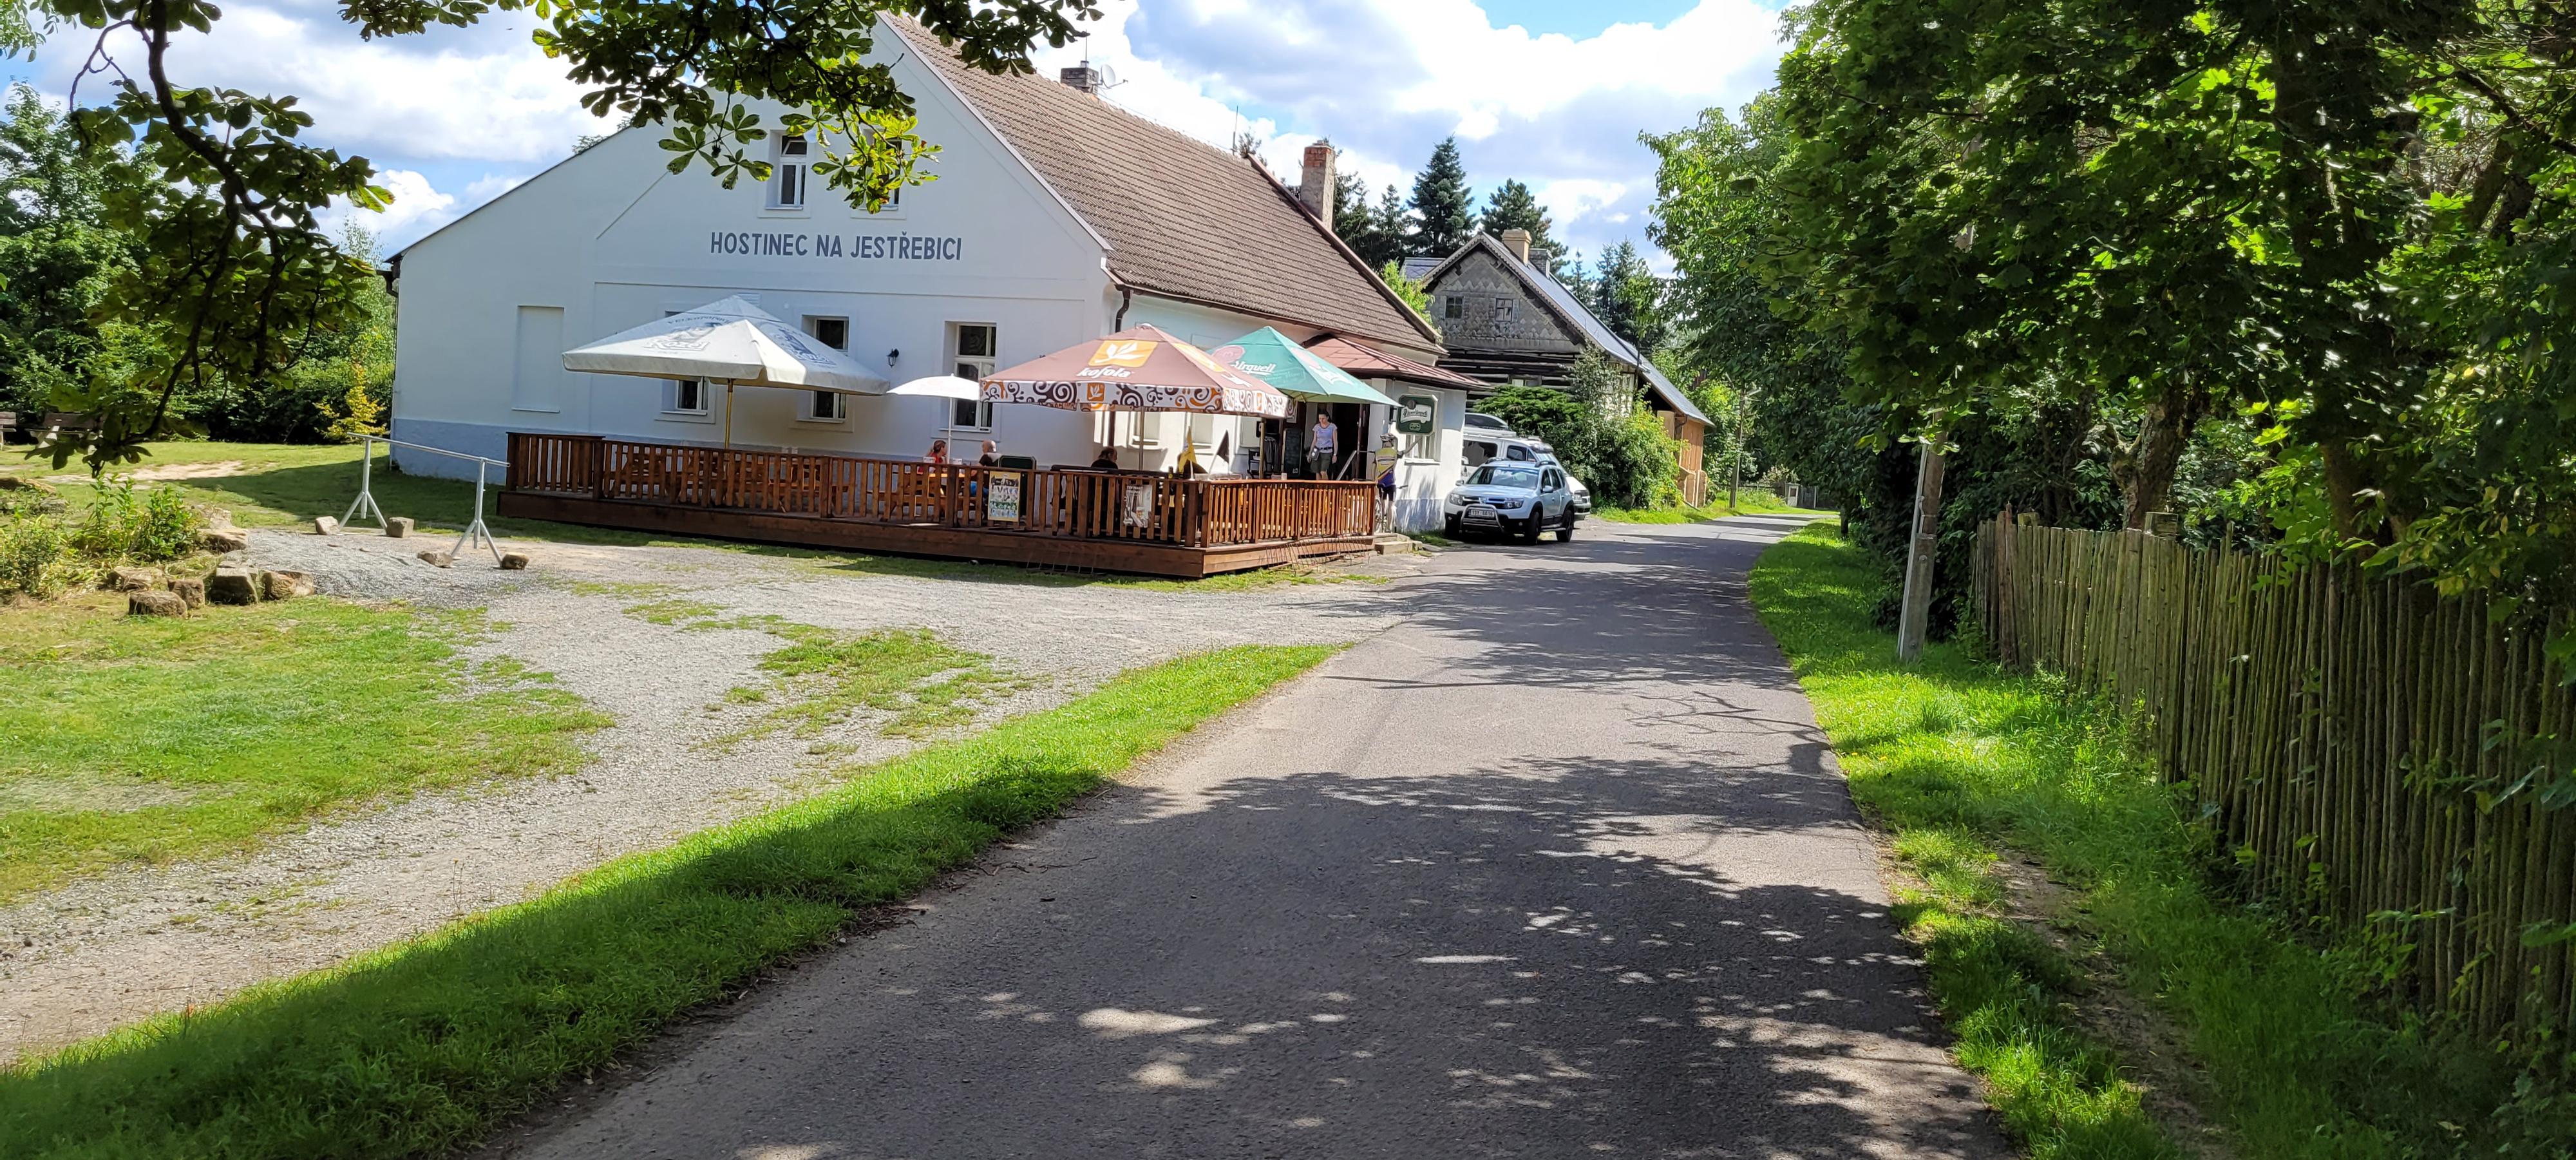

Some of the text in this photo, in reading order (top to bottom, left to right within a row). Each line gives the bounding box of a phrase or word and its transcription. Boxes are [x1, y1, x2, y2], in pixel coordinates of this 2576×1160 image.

[710, 231, 961, 260] HOSTINEC NA JESTŘEBICI
[1076, 365, 1132, 379] kofola
